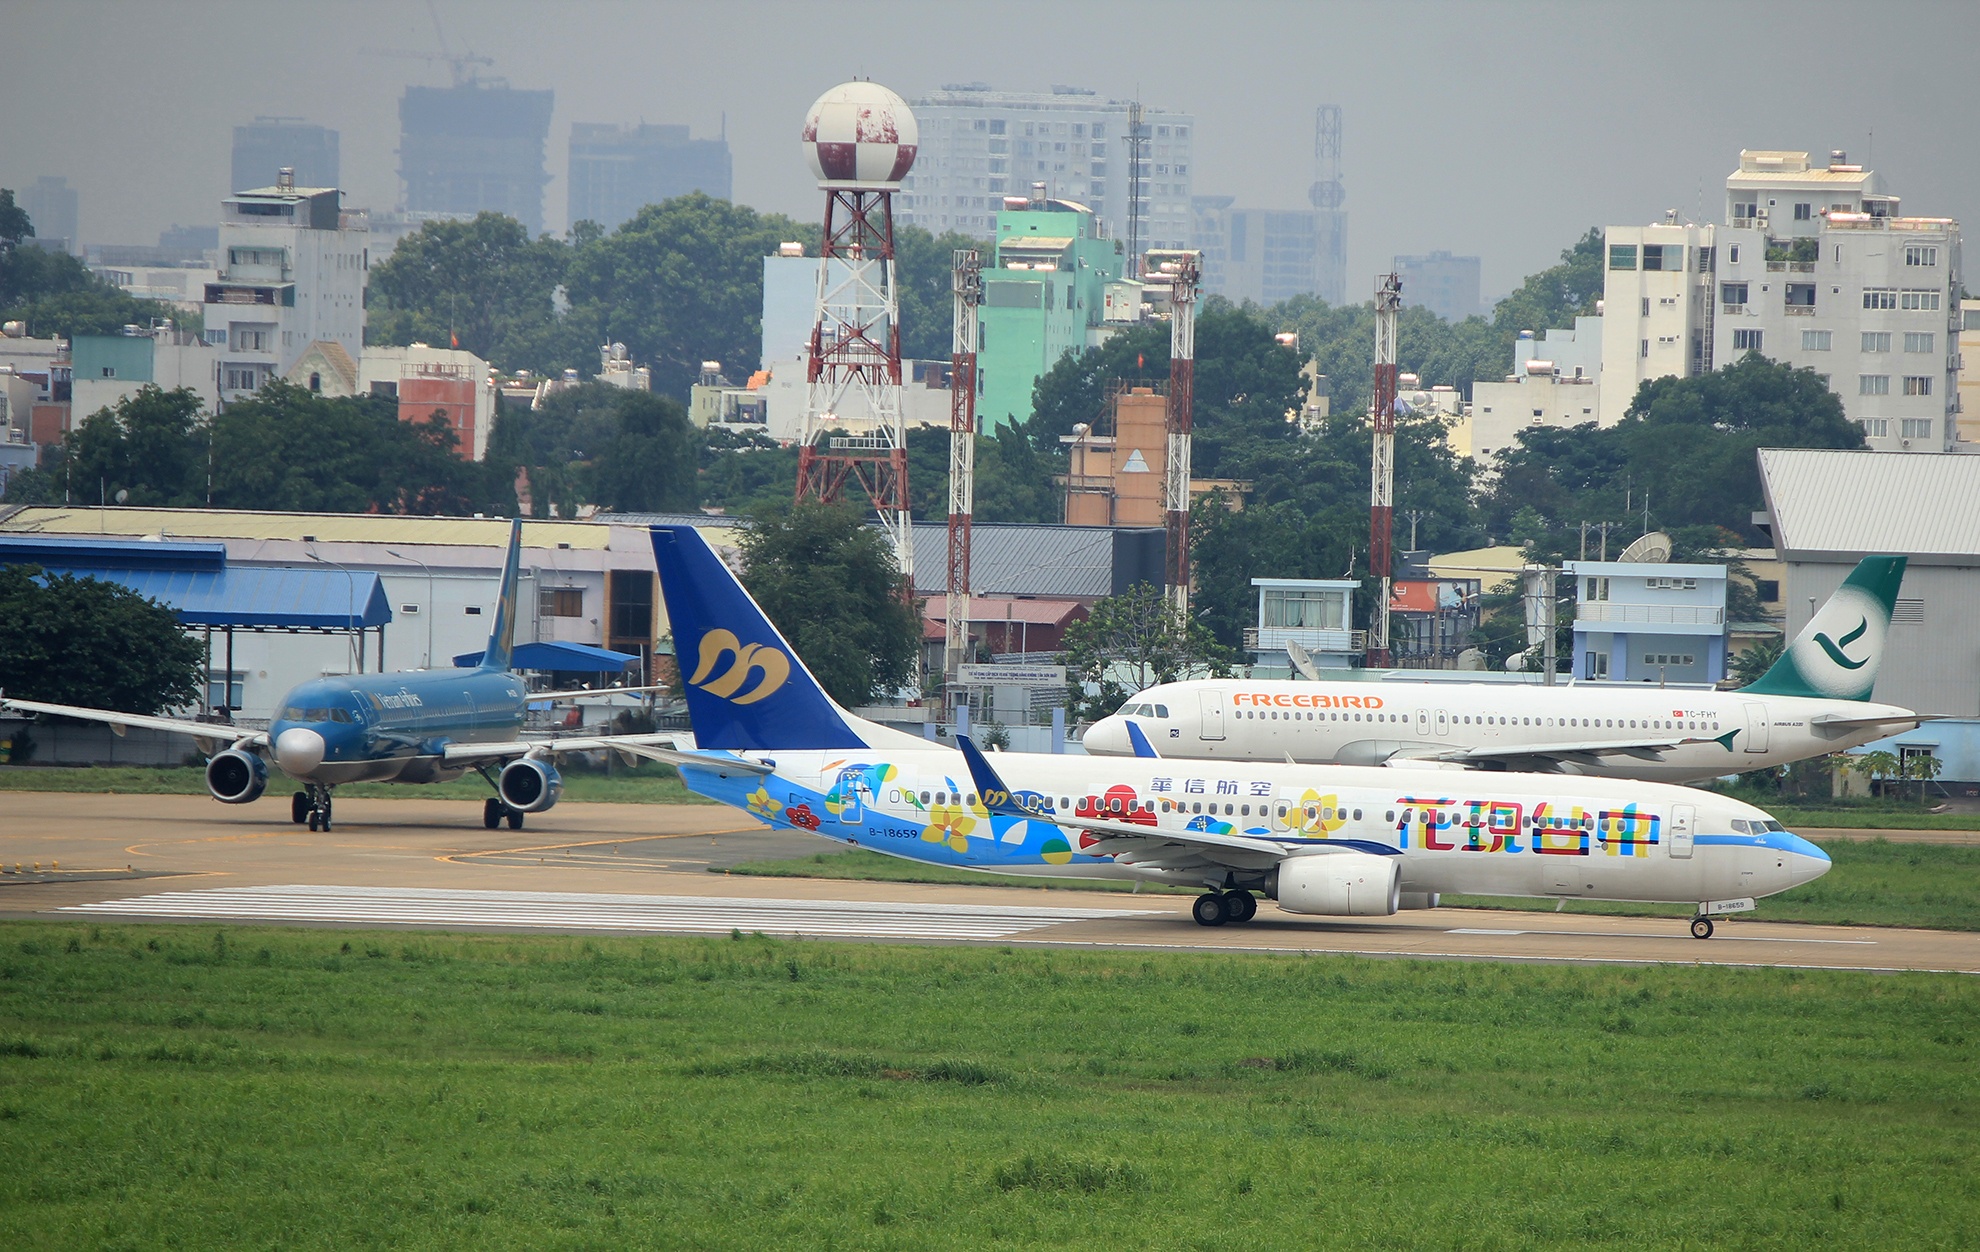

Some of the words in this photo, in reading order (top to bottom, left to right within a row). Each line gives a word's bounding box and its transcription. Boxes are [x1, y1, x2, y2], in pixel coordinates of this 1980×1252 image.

[1233, 693, 1384, 709] FREEBIRD
[1685, 710, 1717, 718] TC-FHY
[1151, 777, 1271, 796] 華信航空
[869, 827, 917, 839] B-18659
[1717, 902, 1745, 910] B-18659
